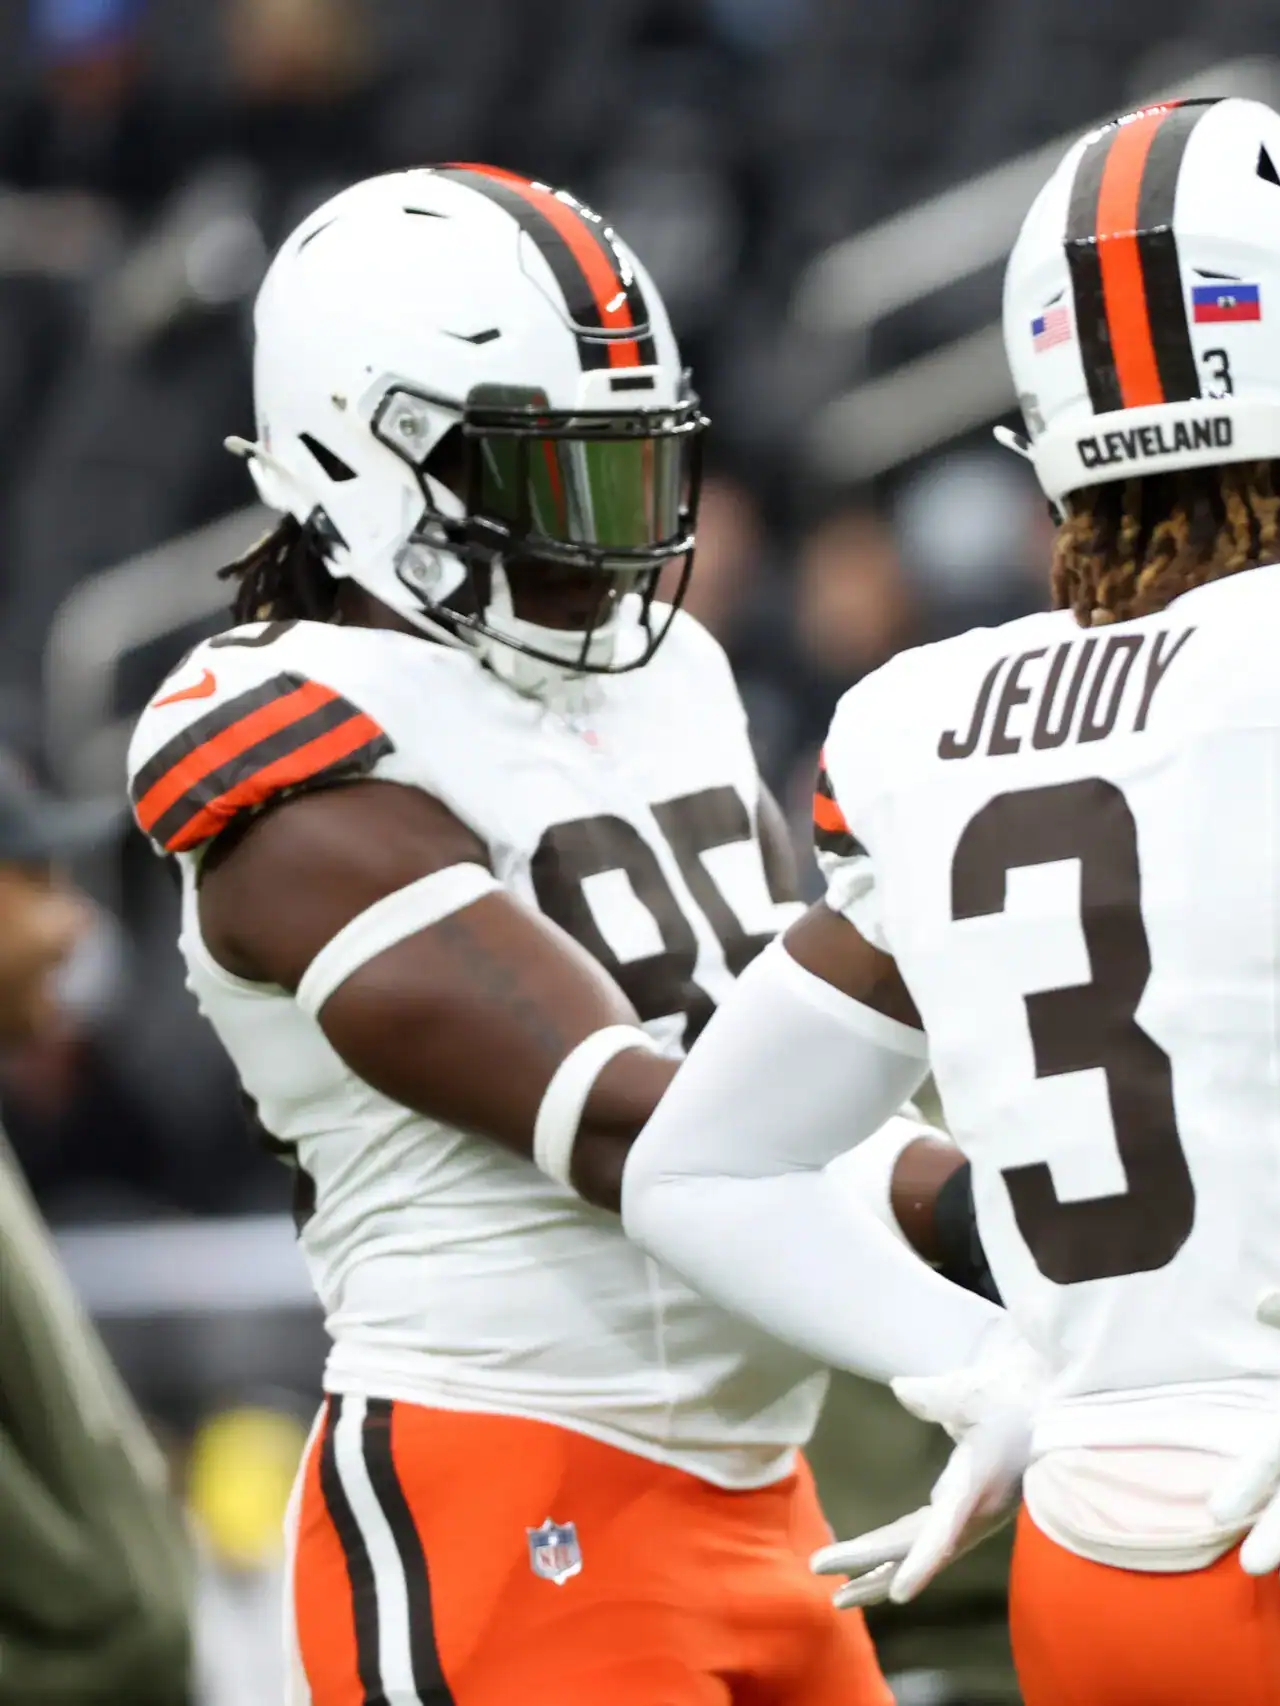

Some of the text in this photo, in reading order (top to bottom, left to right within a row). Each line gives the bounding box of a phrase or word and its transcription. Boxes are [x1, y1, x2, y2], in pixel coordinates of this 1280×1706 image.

[1202, 348, 1233, 399] 3
[1077, 416, 1233, 468] CLEVELAND
[937, 626, 1197, 760] JEUDY
[951, 776, 1196, 1285] 3
